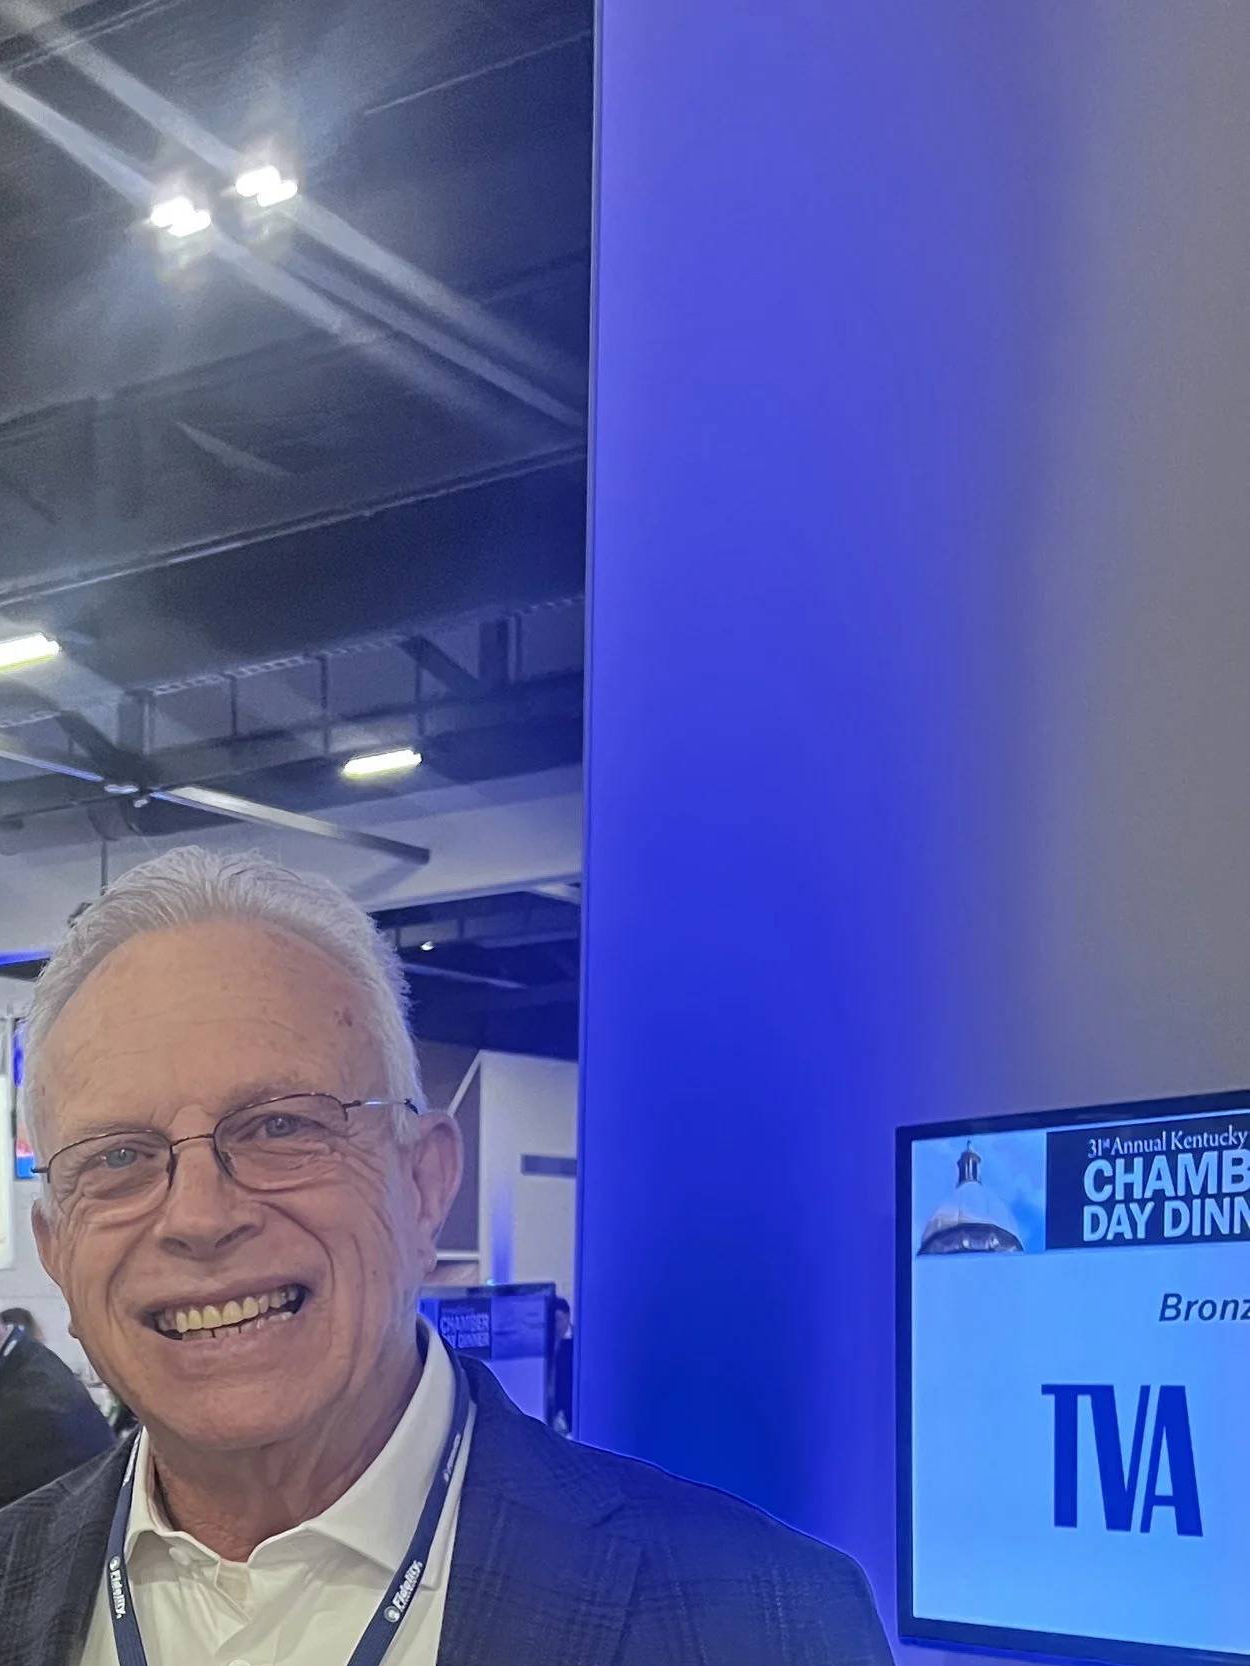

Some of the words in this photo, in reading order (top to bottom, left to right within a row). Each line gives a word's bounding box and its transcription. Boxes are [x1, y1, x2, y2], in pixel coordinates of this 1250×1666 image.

[1110, 1131, 1167, 1156] Annual
[1171, 1125, 1248, 1149] Kentucky
[1083, 1149, 1250, 1203] CHAMB
[1083, 1201, 1154, 1242] DAY
[1041, 1383, 1203, 1537] TVA
